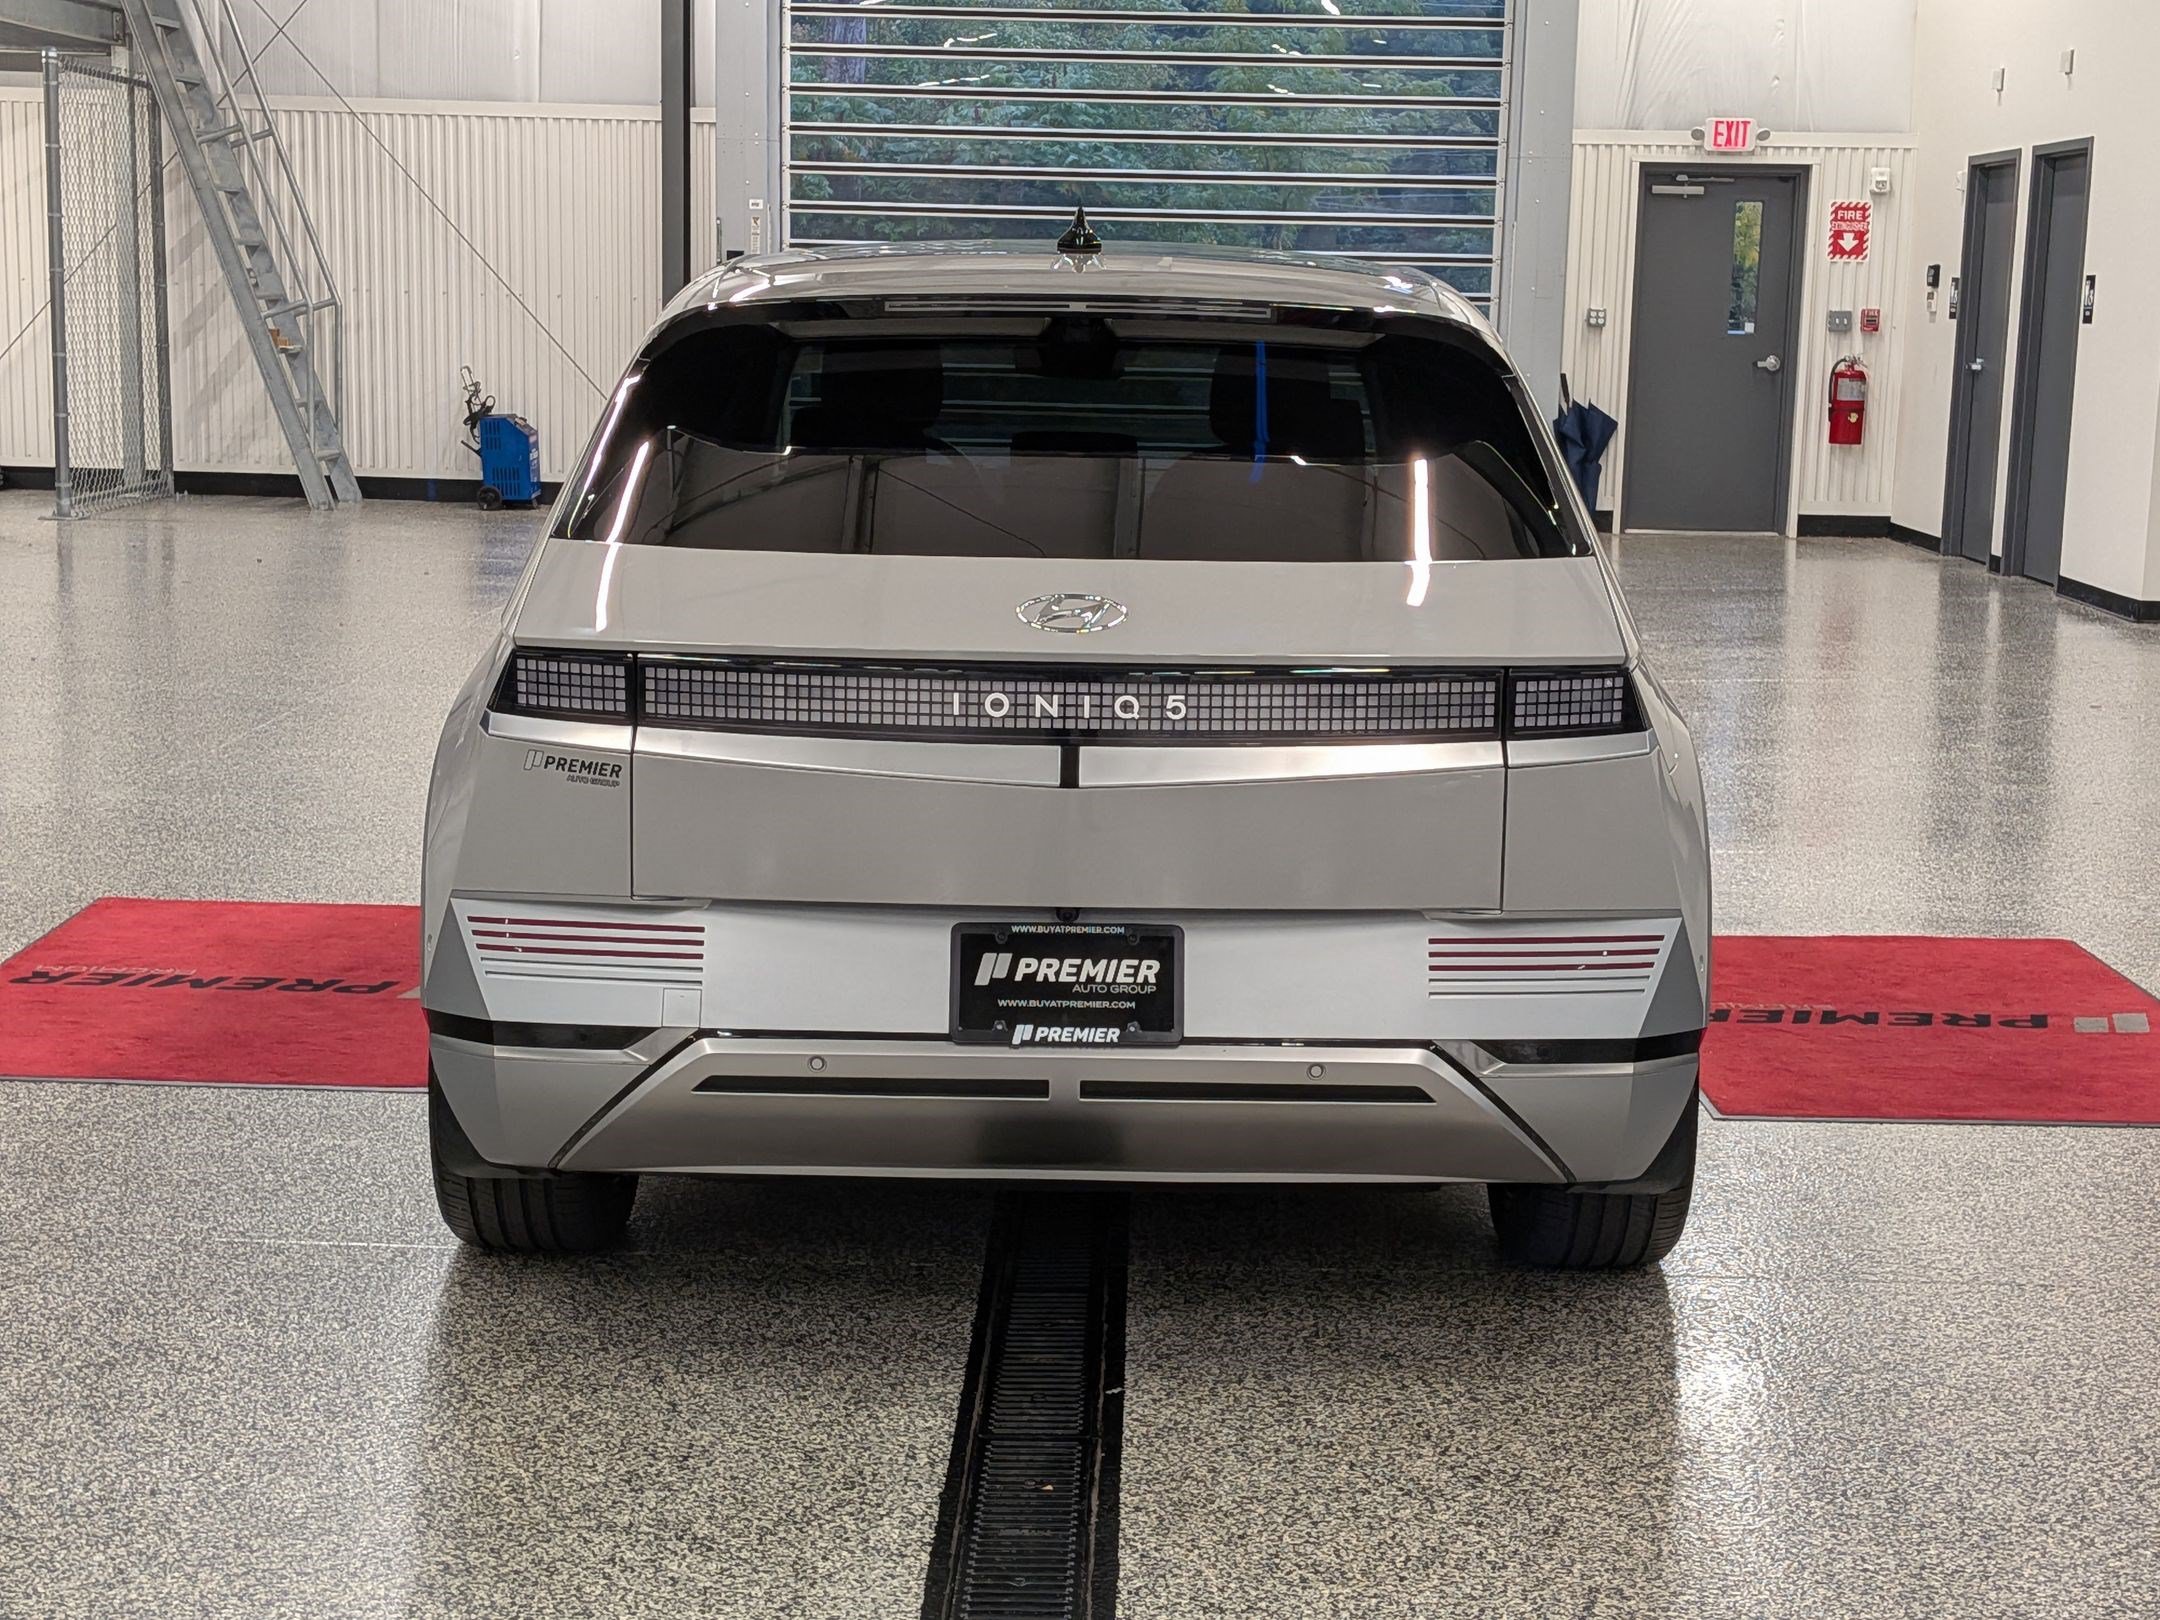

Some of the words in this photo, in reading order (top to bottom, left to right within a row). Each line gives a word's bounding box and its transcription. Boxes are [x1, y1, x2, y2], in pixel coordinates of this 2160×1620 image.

[1713, 120, 1751, 147] EXIT
[1837, 210, 1864, 220] FIRE
[544, 755, 622, 779] PREMIER
[1011, 925, 1125, 935] WWW.BUYATPREMIER.COM
[1014, 957, 1161, 984] PREMIER
[9, 970, 399, 994] PREMIER
[1072, 984, 1108, 994] AUTO
[1110, 985, 1157, 995] GROUP
[997, 999, 1136, 1010] WWW.BUYATPREMIER.COM
[1034, 1027, 1121, 1043] PREMIER
